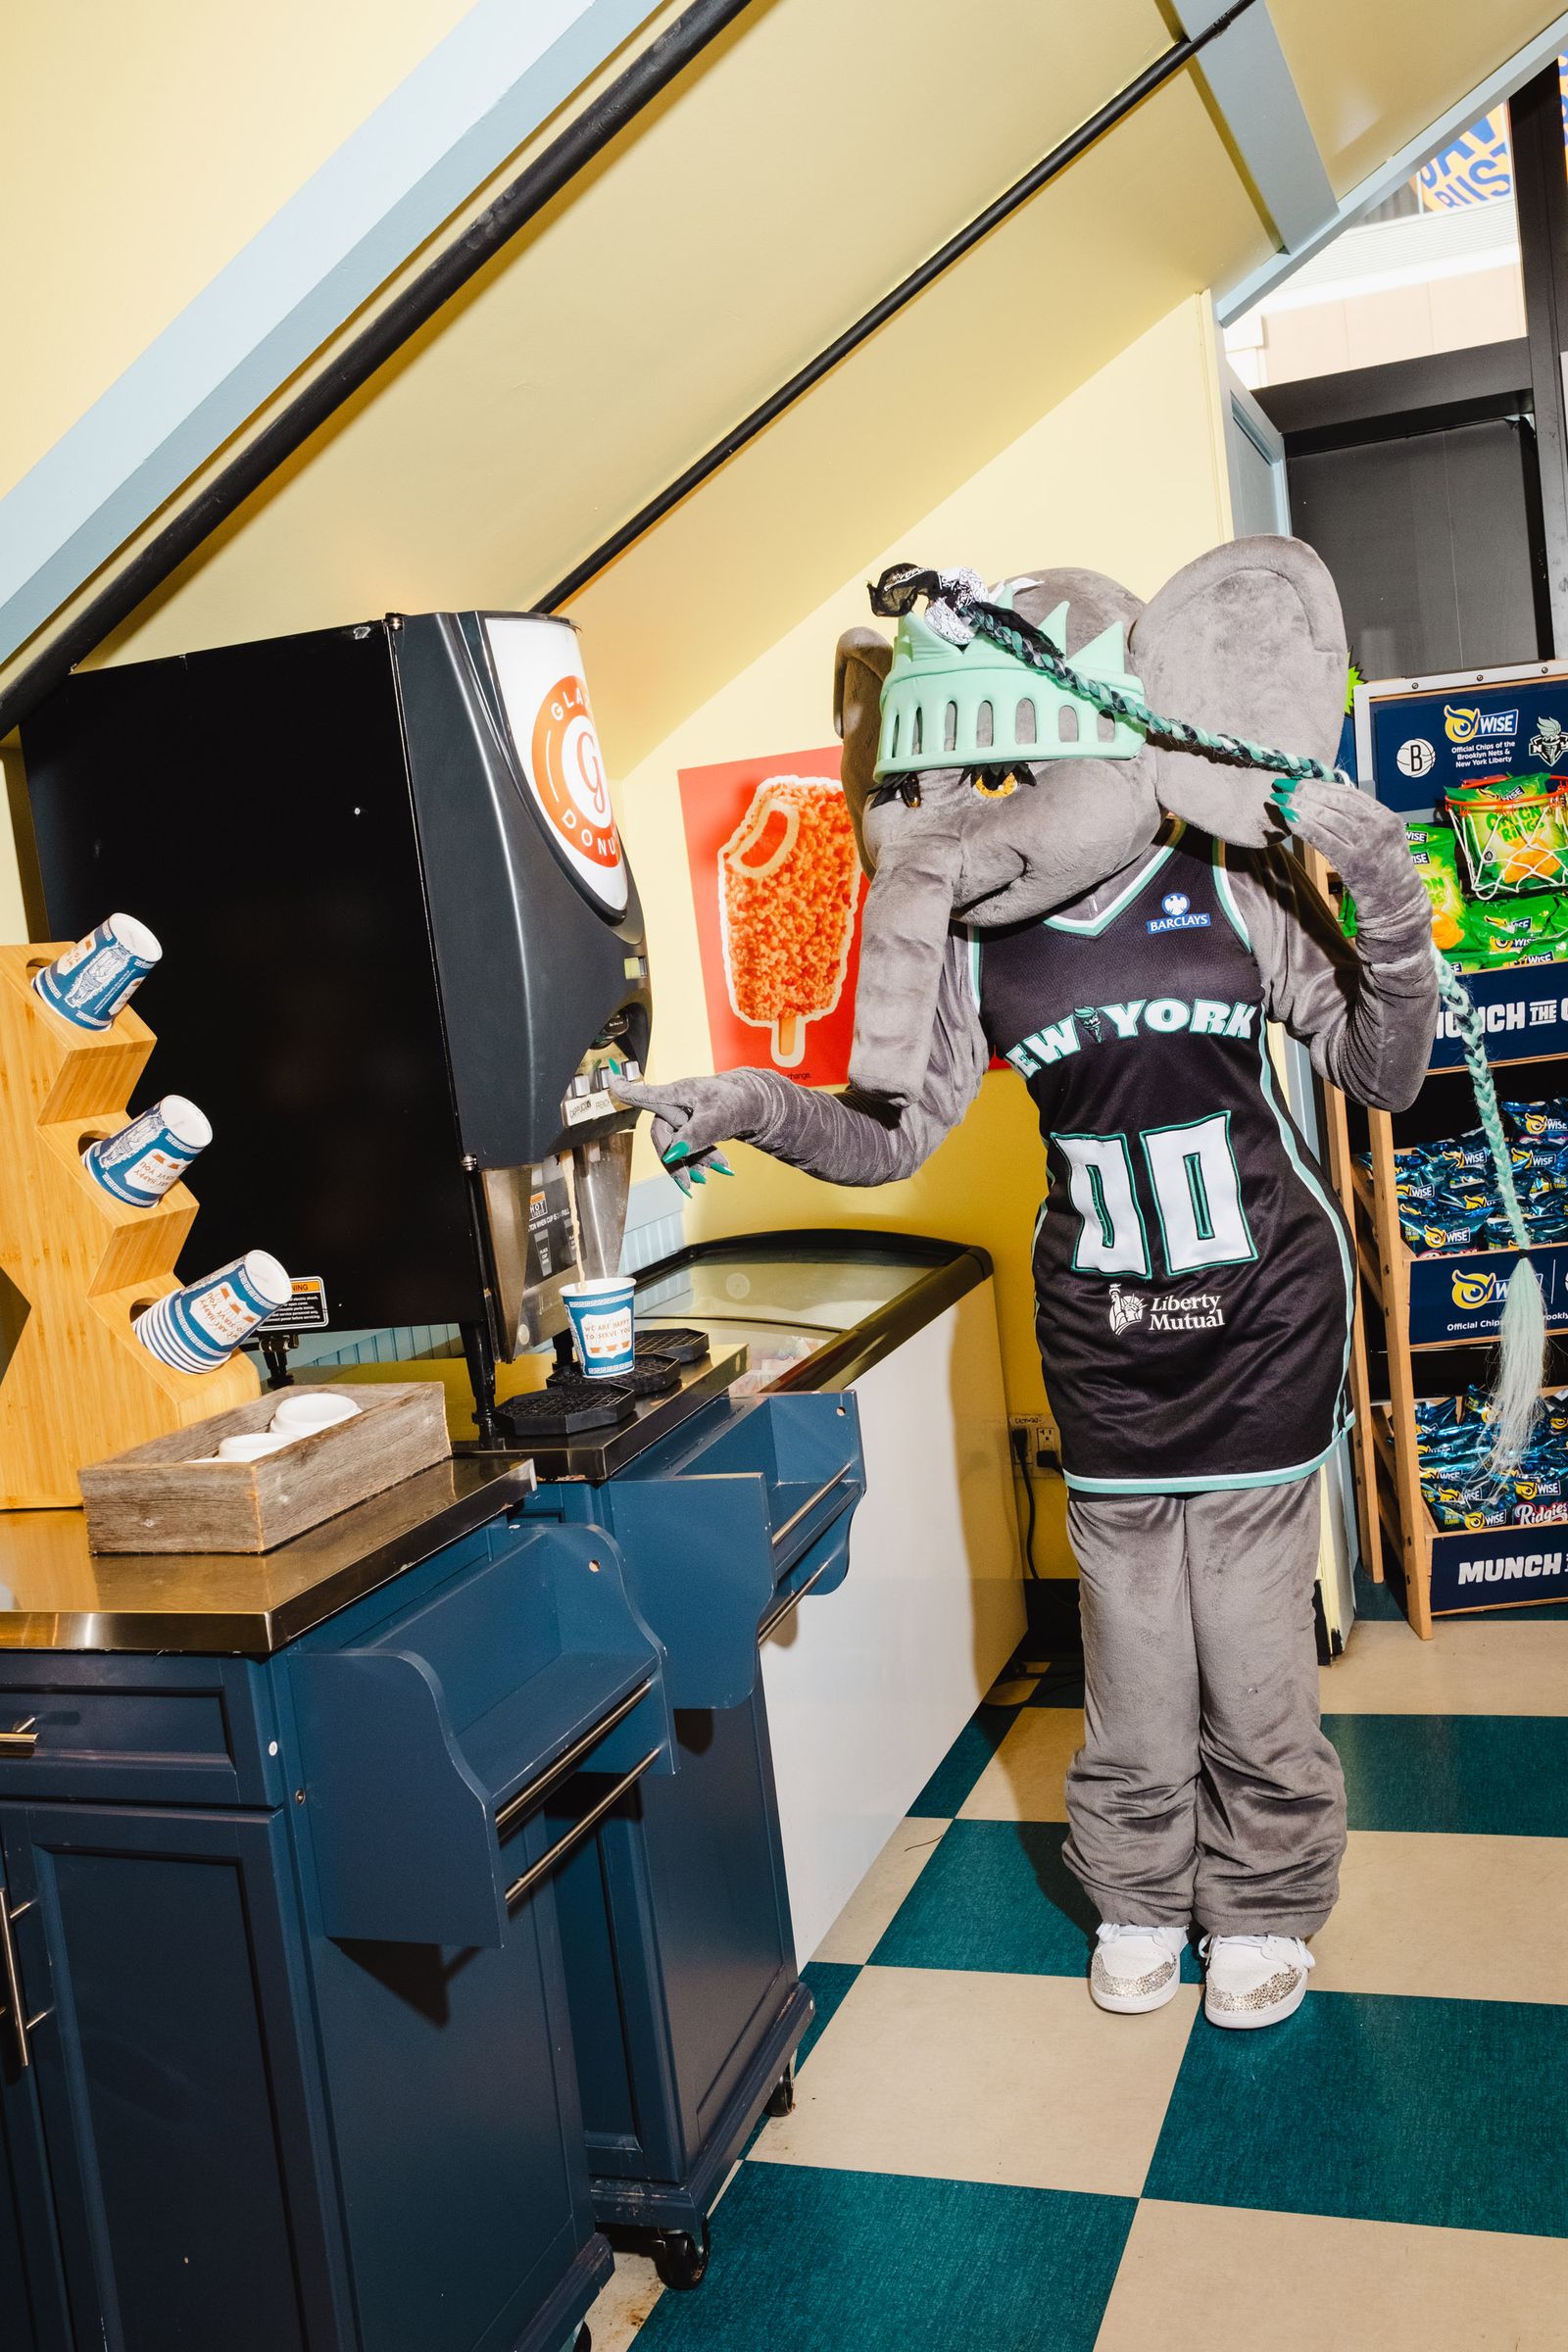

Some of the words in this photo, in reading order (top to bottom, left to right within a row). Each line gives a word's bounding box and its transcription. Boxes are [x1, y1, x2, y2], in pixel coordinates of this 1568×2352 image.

[1480, 714, 1514, 734] WISE
[1410, 745, 1422, 772] B
[1456, 752, 1487, 760] Brooklyn
[1489, 756, 1512, 764] Liberty
[1413, 853, 1428, 863] ISE
[1150, 914, 1208, 932] BARCLAYS
[1436, 1001, 1525, 1039] UCH
[1530, 1004, 1556, 1022] THE
[1004, 1014, 1081, 1081] EW
[1098, 998, 1257, 1039] YORK
[1465, 1152, 1485, 1165] WISE
[1050, 1109, 1259, 1281] 00
[1411, 1186, 1433, 1198] WISE
[530, 1201, 544, 1212] HOT
[1446, 1230, 1468, 1243] WISE
[1151, 1294, 1222, 1315] Liberty
[1149, 1309, 1226, 1331] Mutual
[1446, 1320, 1478, 1332] Official
[1480, 1319, 1500, 1330] Chip
[1537, 1483, 1558, 1494] WISE
[1485, 1511, 1504, 1526] WISE
[1458, 1552, 1562, 1586] MUNCH
